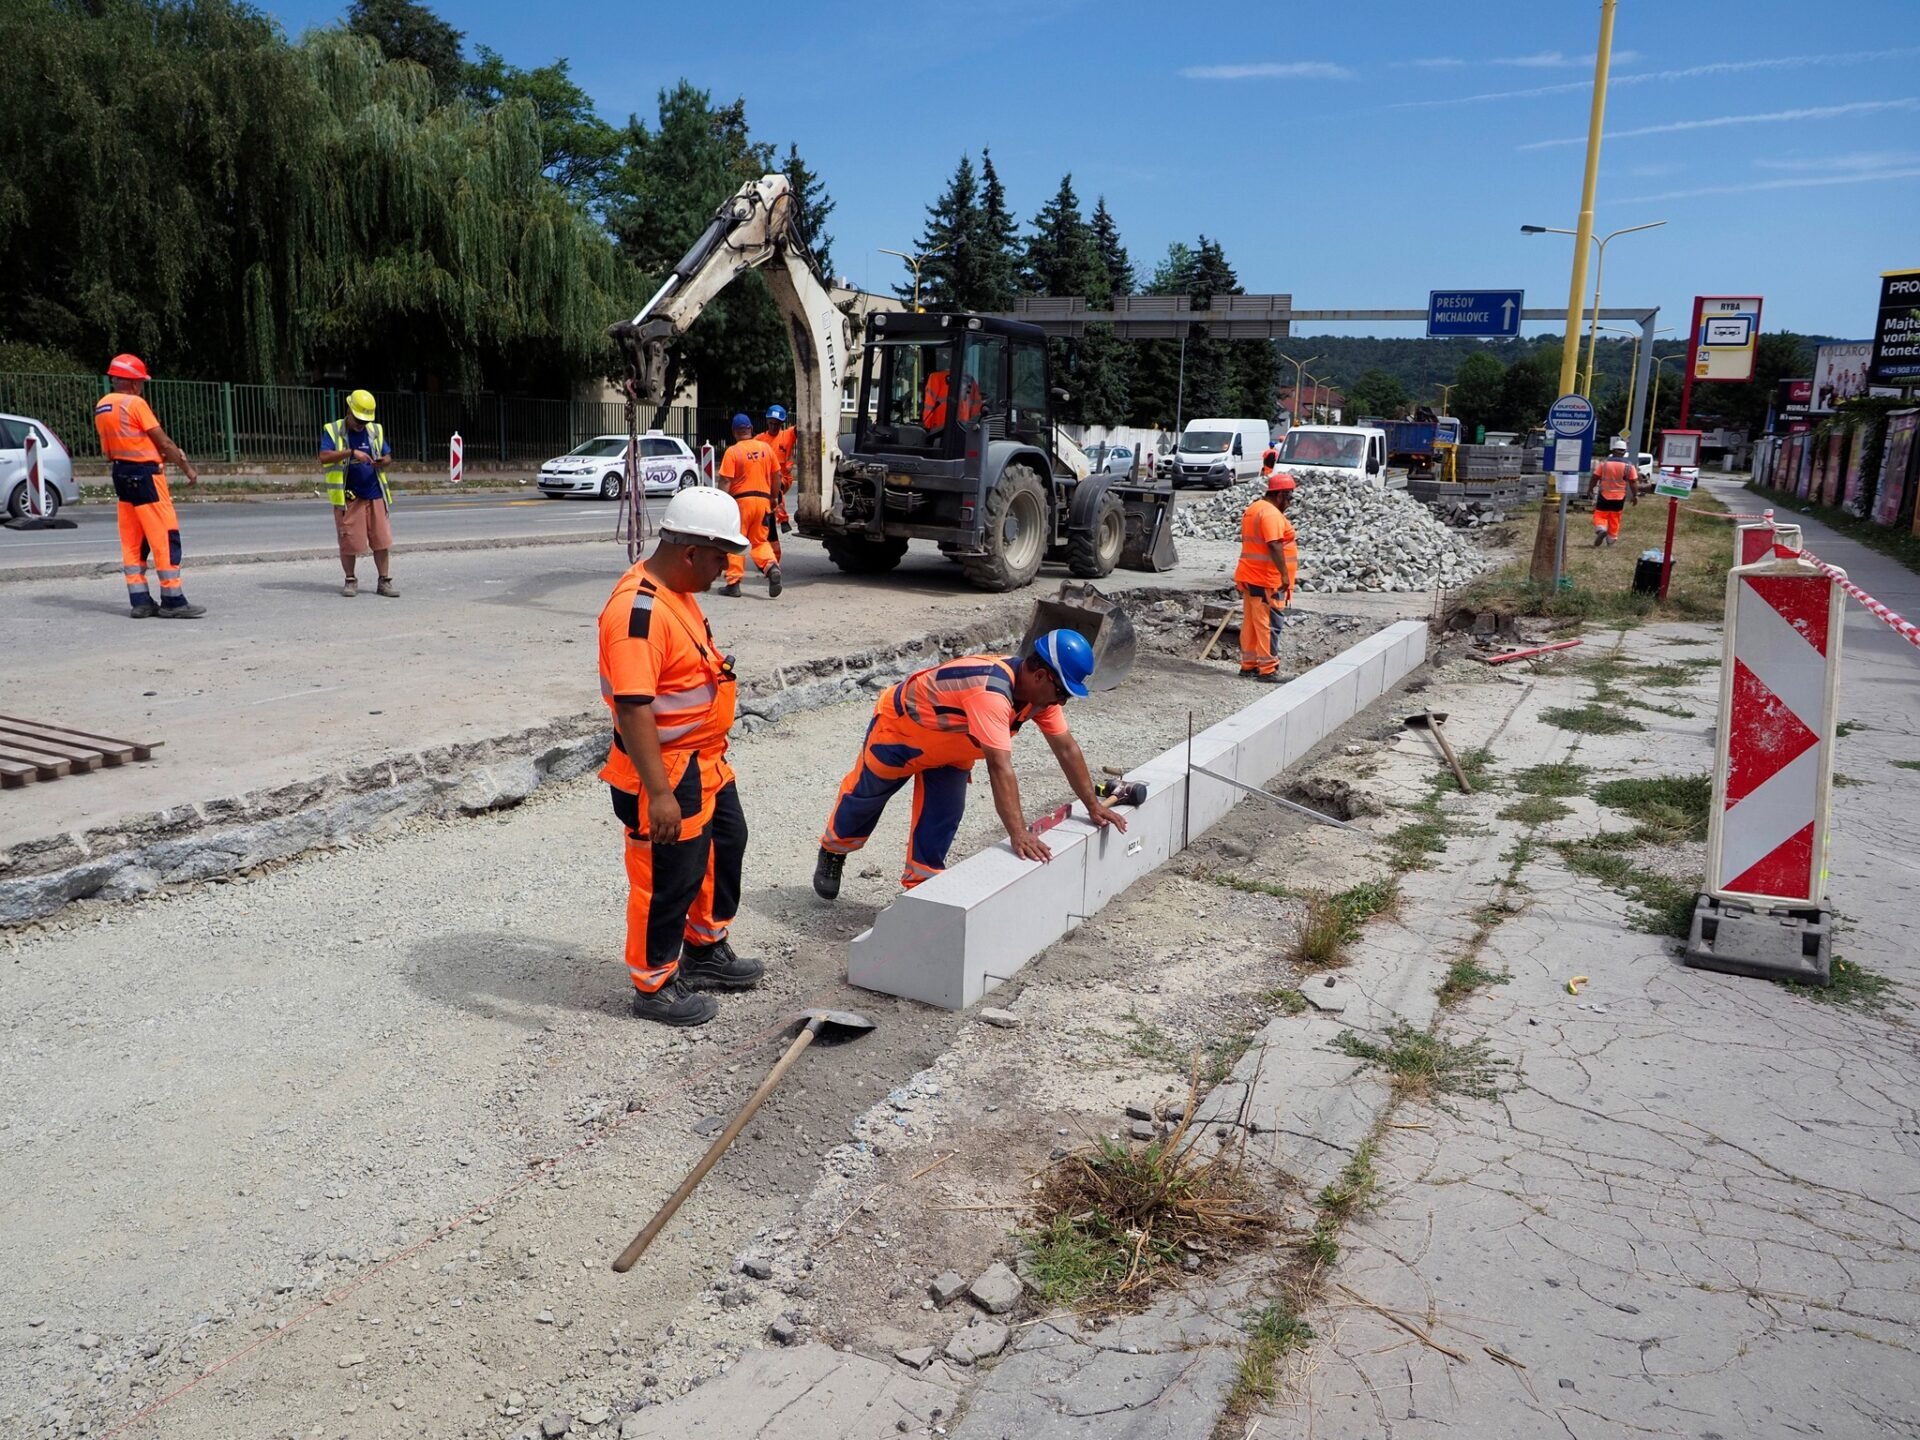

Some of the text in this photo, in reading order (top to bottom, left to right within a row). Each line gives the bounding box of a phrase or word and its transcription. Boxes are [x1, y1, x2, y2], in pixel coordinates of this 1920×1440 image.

[1889, 281, 1920, 294] PRO
[1437, 295, 1474, 308] PREŠOV
[1720, 303, 1741, 311] RYBA
[1435, 311, 1489, 322] MICHALOVCE
[1881, 344, 1920, 357] koneč
[826, 331, 838, 391] TEREX
